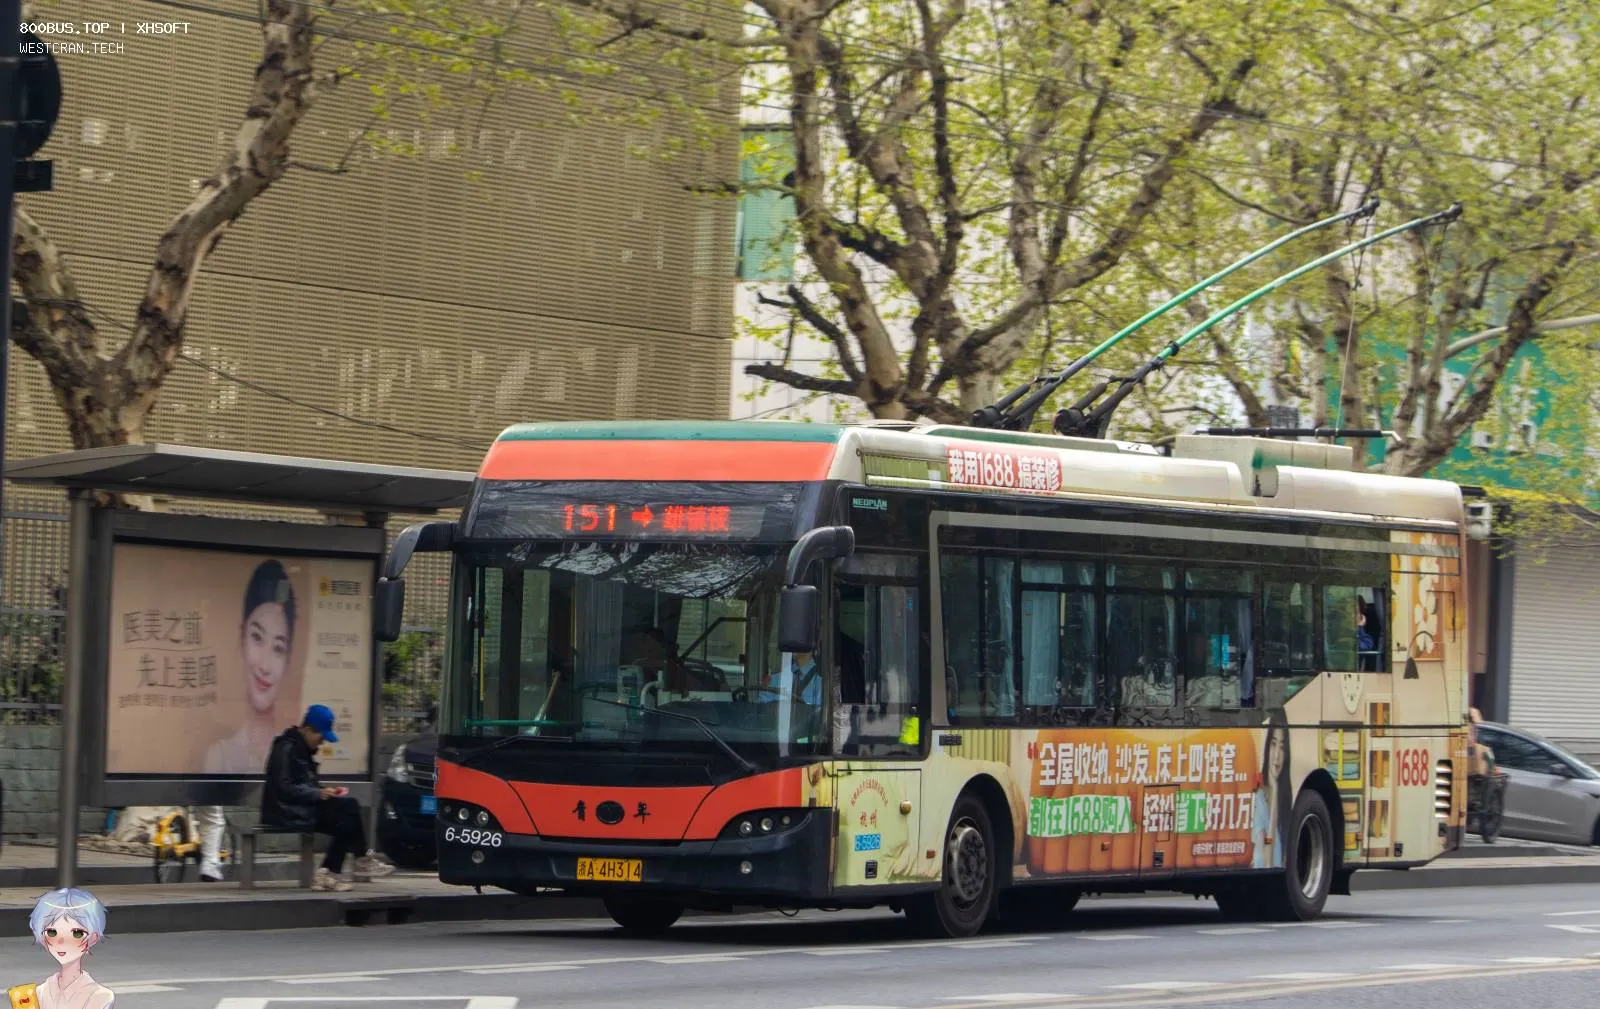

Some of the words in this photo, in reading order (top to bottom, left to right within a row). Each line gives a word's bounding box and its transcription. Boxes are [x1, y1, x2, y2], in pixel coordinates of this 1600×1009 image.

[852, 498, 888, 510] NEOPLAN
[562, 503, 616, 531] 151
[122, 609, 203, 645] 医美之前
[1396, 748, 1429, 787] 1688
[445, 826, 502, 848] 6-5926
[855, 834, 881, 851] 6-5926
